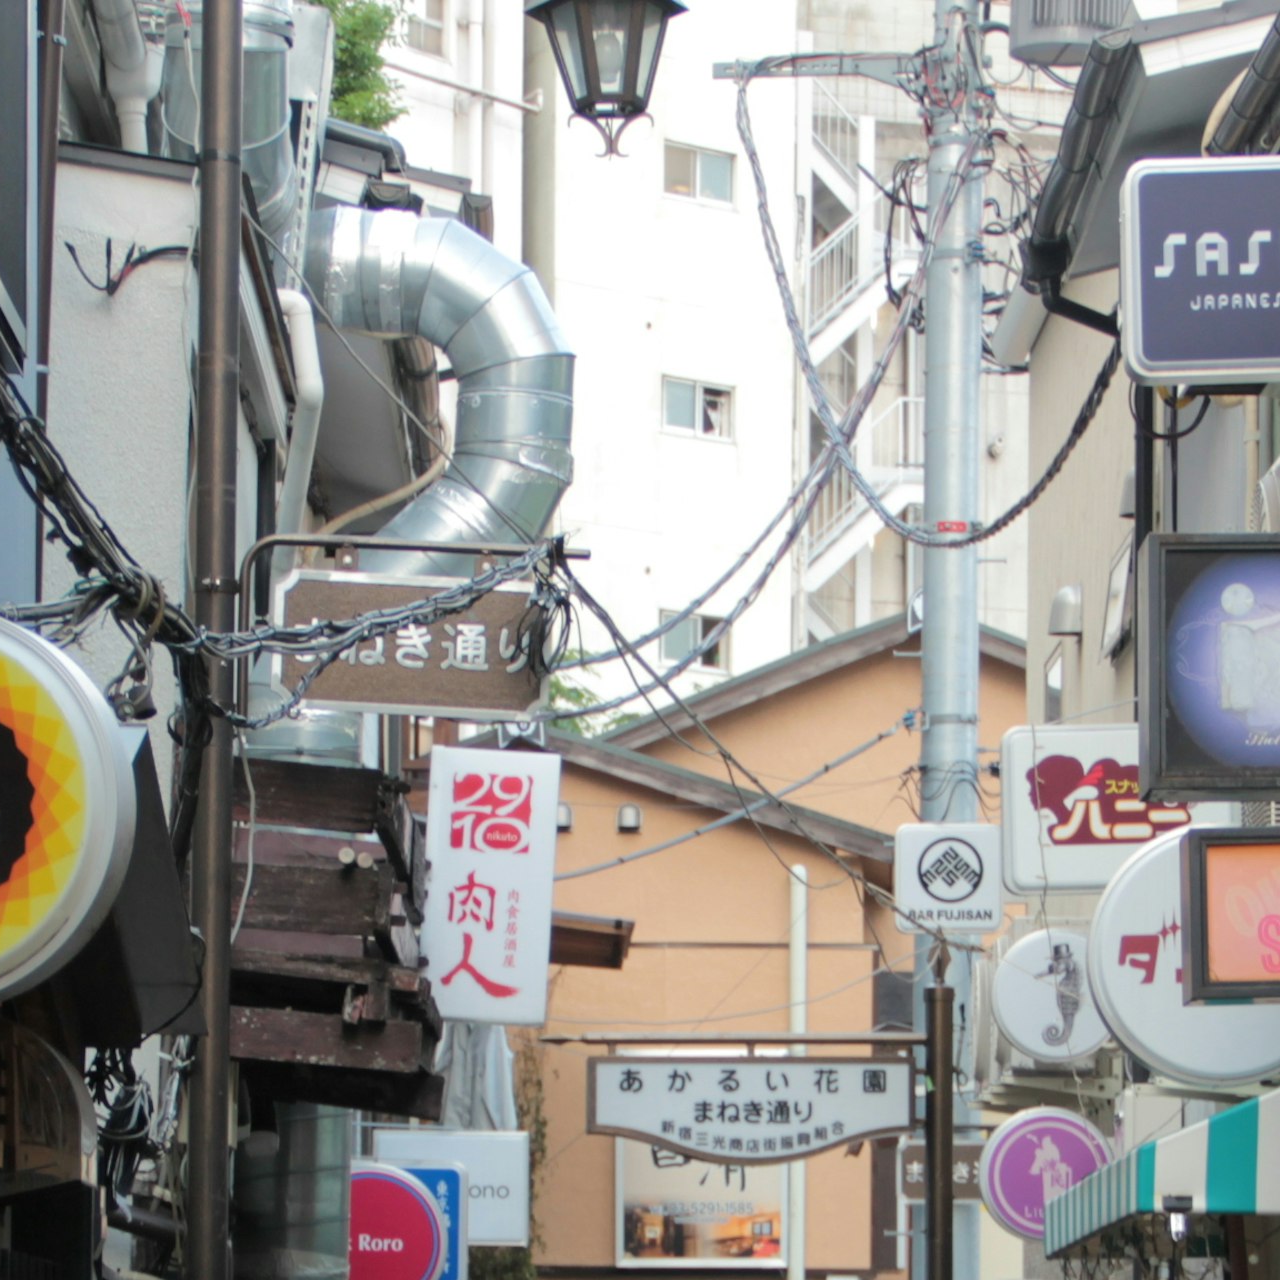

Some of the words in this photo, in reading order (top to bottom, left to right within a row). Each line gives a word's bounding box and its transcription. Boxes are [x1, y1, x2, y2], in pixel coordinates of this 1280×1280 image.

[1104, 778, 1140, 795] スナッ
[486, 829, 518, 843] nikuto
[937, 909, 993, 920] FUJISAN
[619, 1068, 888, 1094] あかるい花園
[693, 1100, 814, 1124] まねき通り
[468, 1184, 510, 1199] ono
[358, 1234, 404, 1252] Roro
